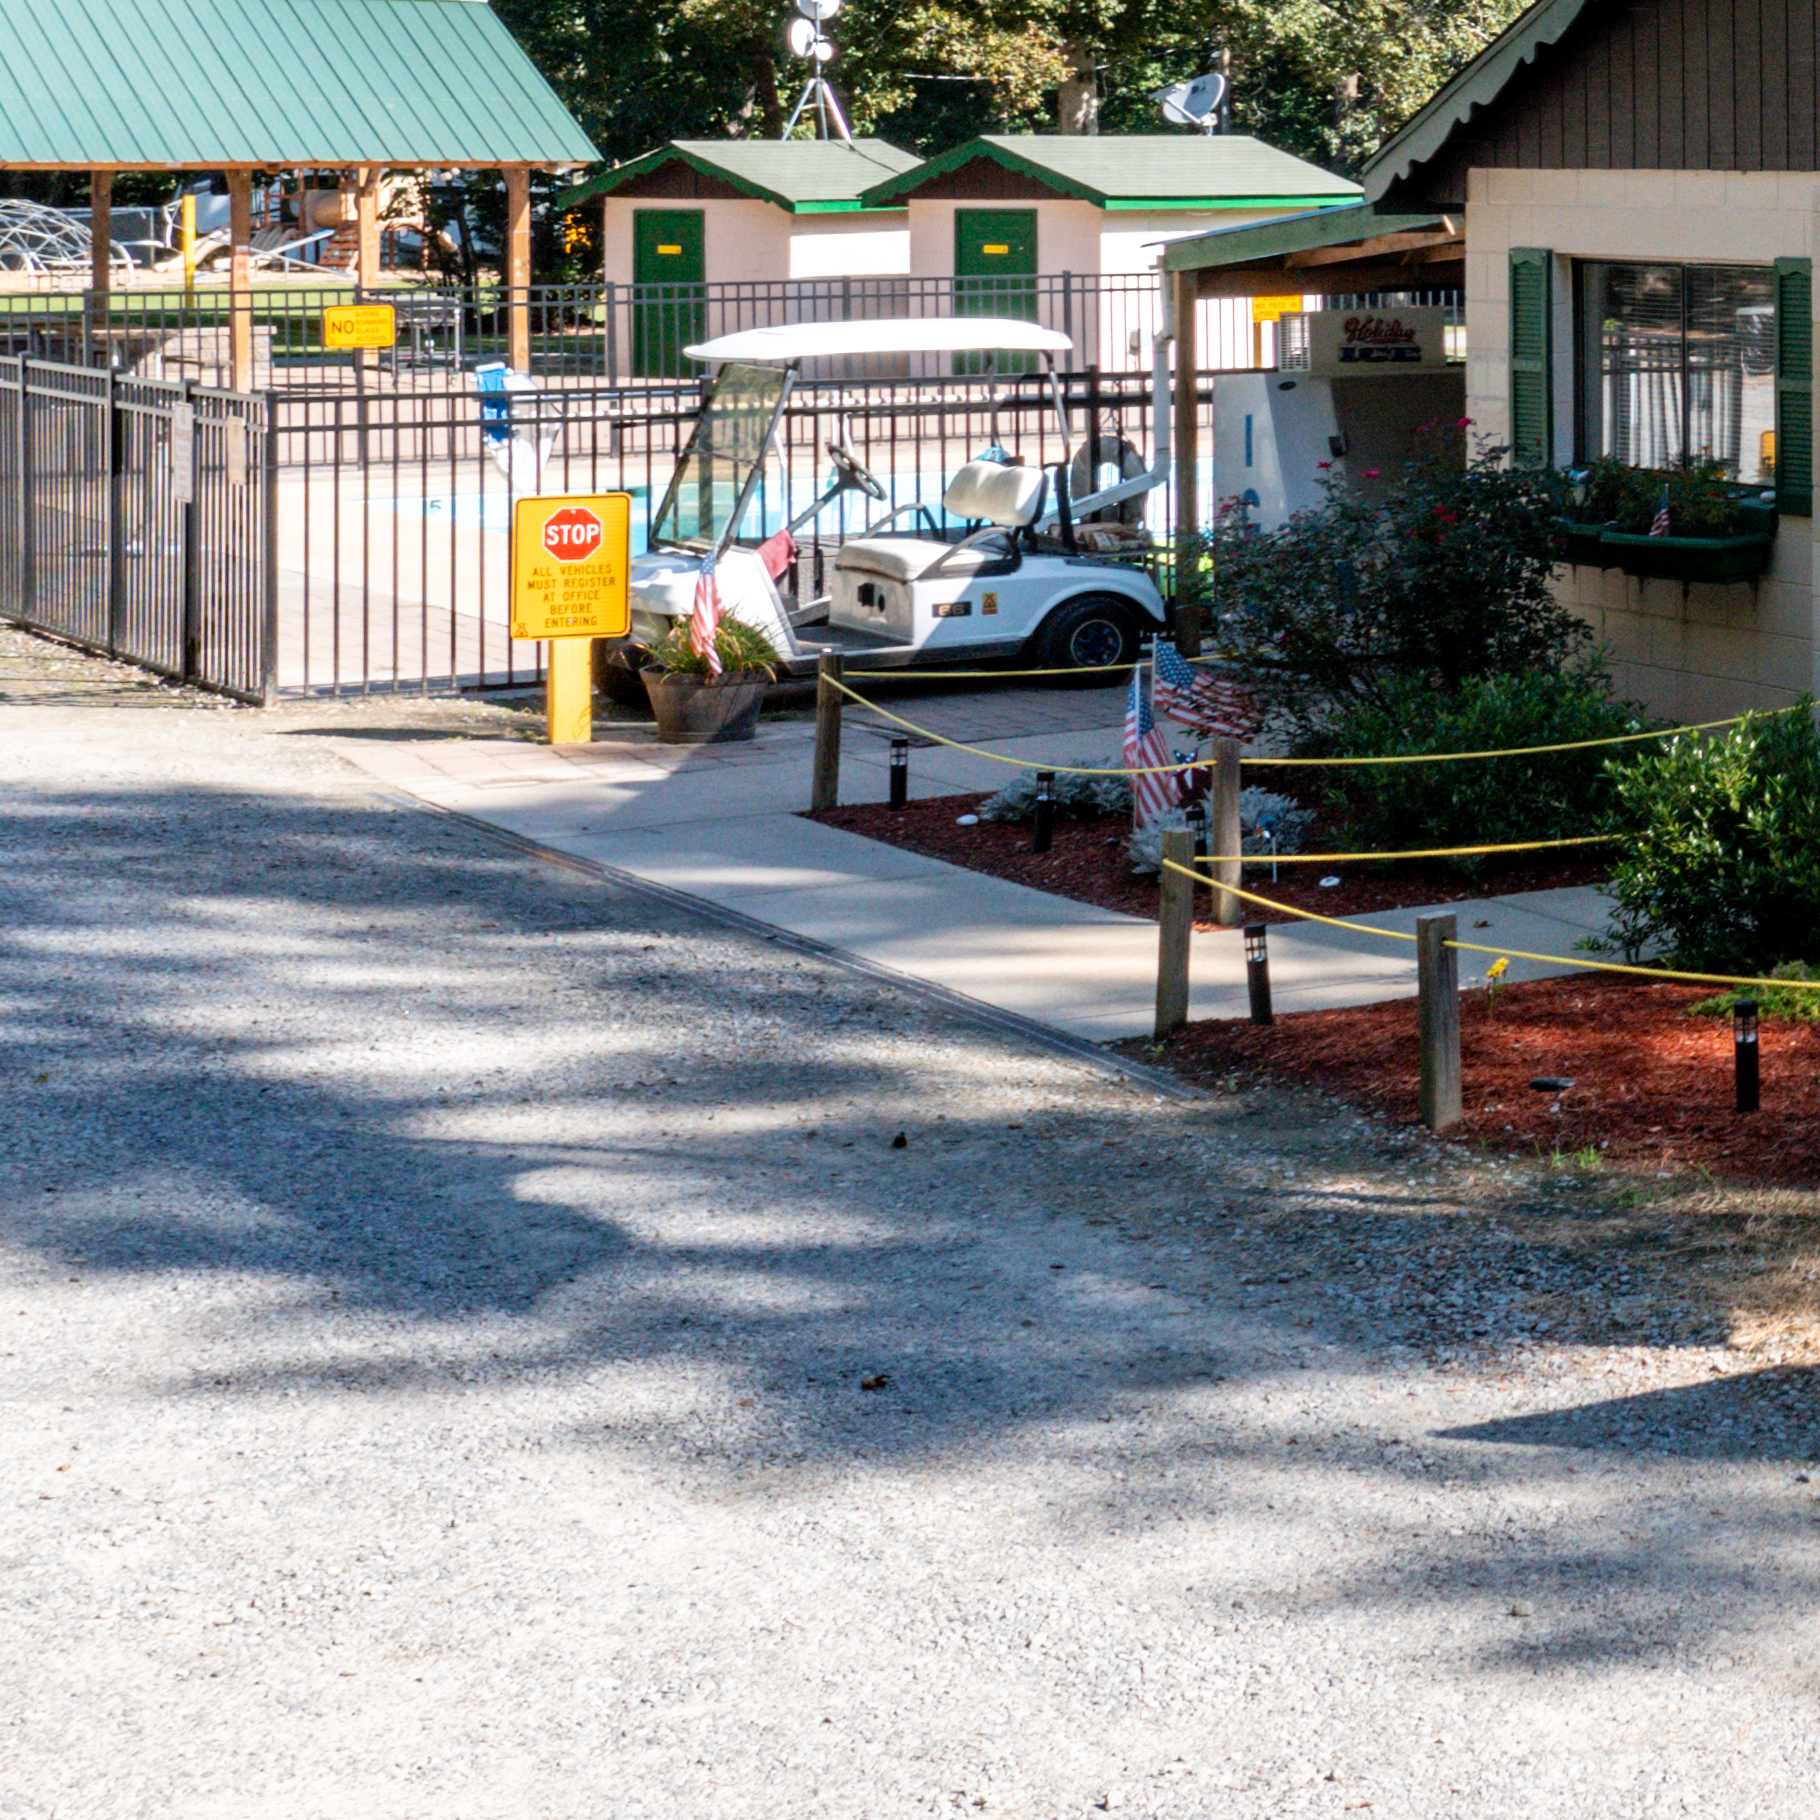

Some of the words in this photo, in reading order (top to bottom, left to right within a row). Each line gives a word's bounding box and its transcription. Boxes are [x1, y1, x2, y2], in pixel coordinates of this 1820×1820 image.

[332, 320, 354, 334] NO
[1345, 315, 1415, 343] Holiday
[546, 524, 599, 545] STOP
[532, 567, 552, 577] ALL
[560, 564, 612, 576] VEHICLES
[527, 579, 556, 590] MUST
[564, 577, 616, 588] REGISTER
[543, 592, 555, 602] AT
[563, 590, 600, 601] OFFICE
[550, 603, 592, 615] BEFORE
[545, 616, 597, 628] ENTERING
